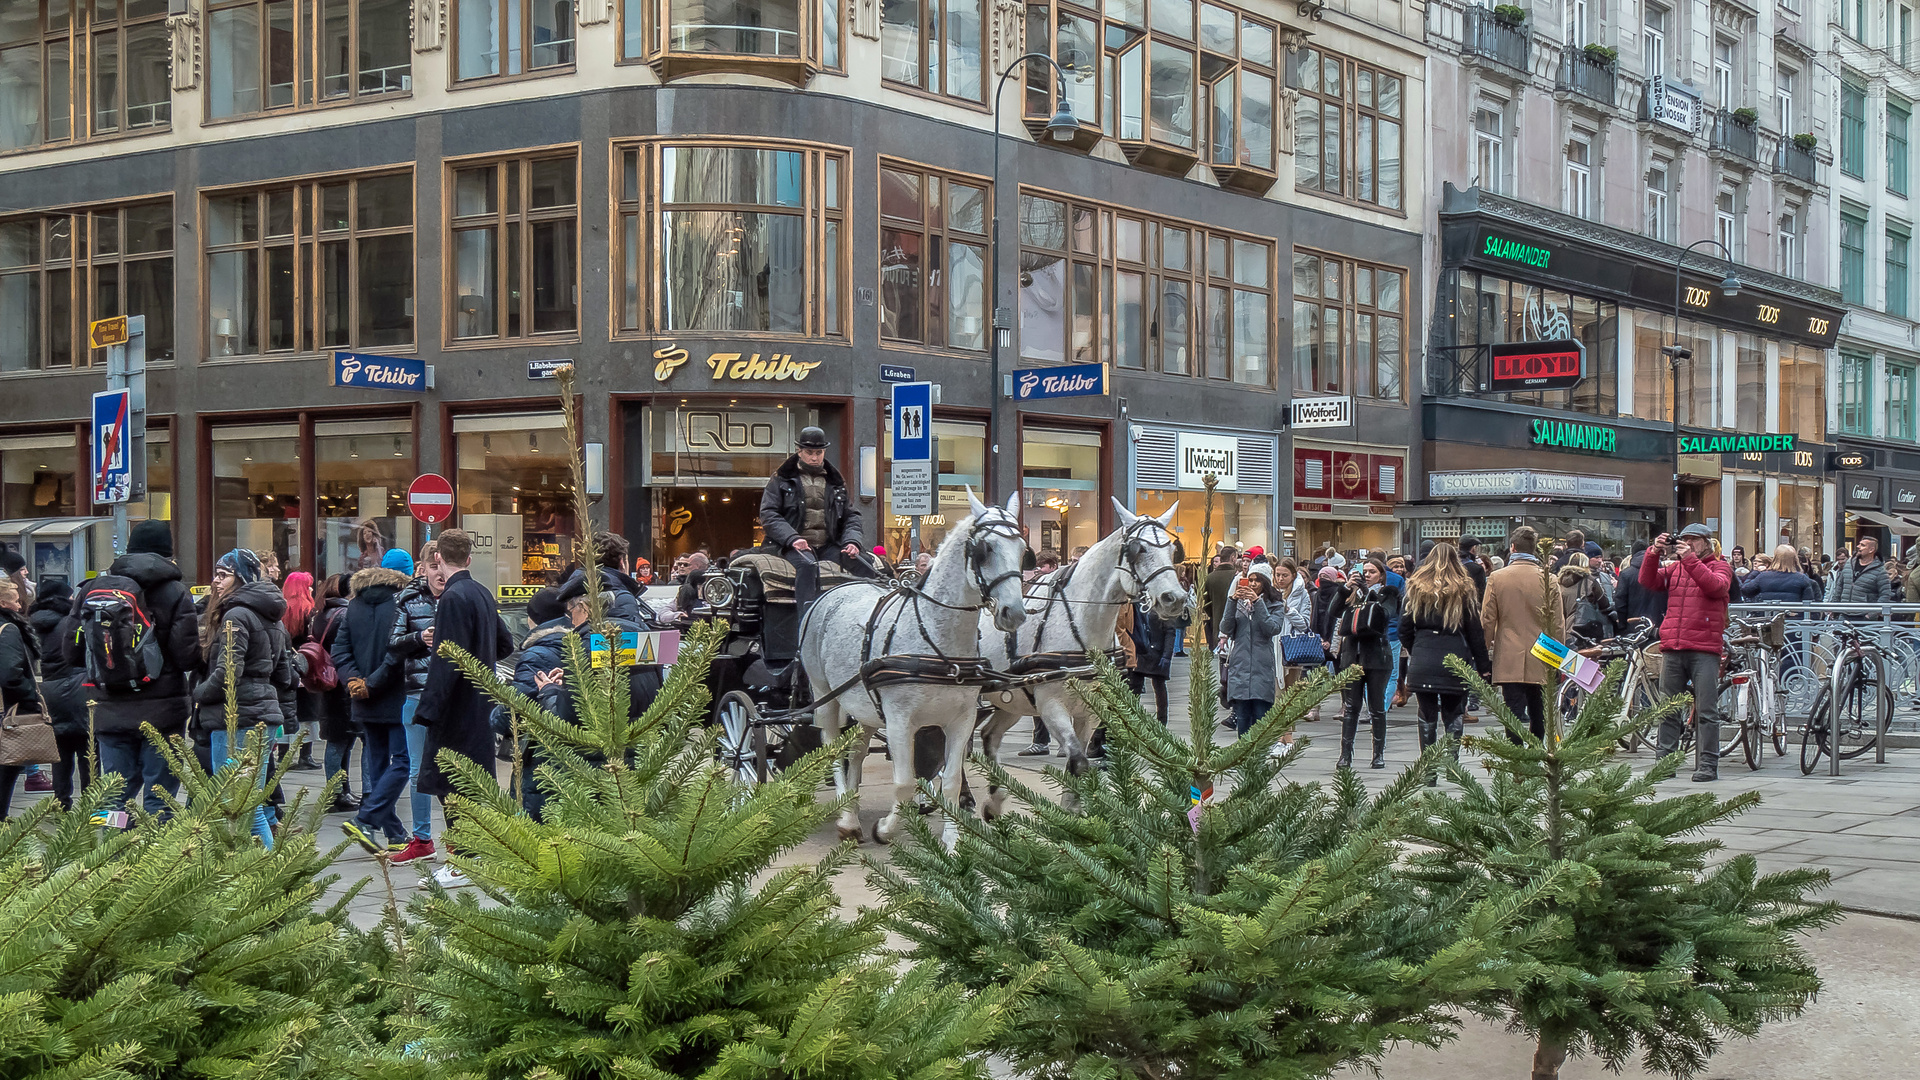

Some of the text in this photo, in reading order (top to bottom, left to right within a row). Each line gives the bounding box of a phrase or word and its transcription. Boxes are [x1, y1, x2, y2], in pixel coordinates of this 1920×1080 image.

[1654, 76, 1662, 118] PENSION
[1484, 236, 1550, 268] SALAMANDER
[364, 365, 420, 385] Tchibo
[706, 353, 822, 382] Tchibo
[1498, 356, 1576, 376] LLOYD
[1042, 374, 1098, 393] Tchibo
[1302, 406, 1338, 418] Wolford
[687, 412, 773, 452] Qbo
[1533, 418, 1616, 452] SALAMANDER
[1680, 434, 1794, 453] SALAMANDER
[1194, 454, 1226, 469] Wolford
[1446, 476, 1511, 488] SOUVENIRS
[1538, 477, 1576, 491] SOUVENIRS
[1852, 484, 1872, 500] Cartier
[1898, 488, 1916, 503] Cartier
